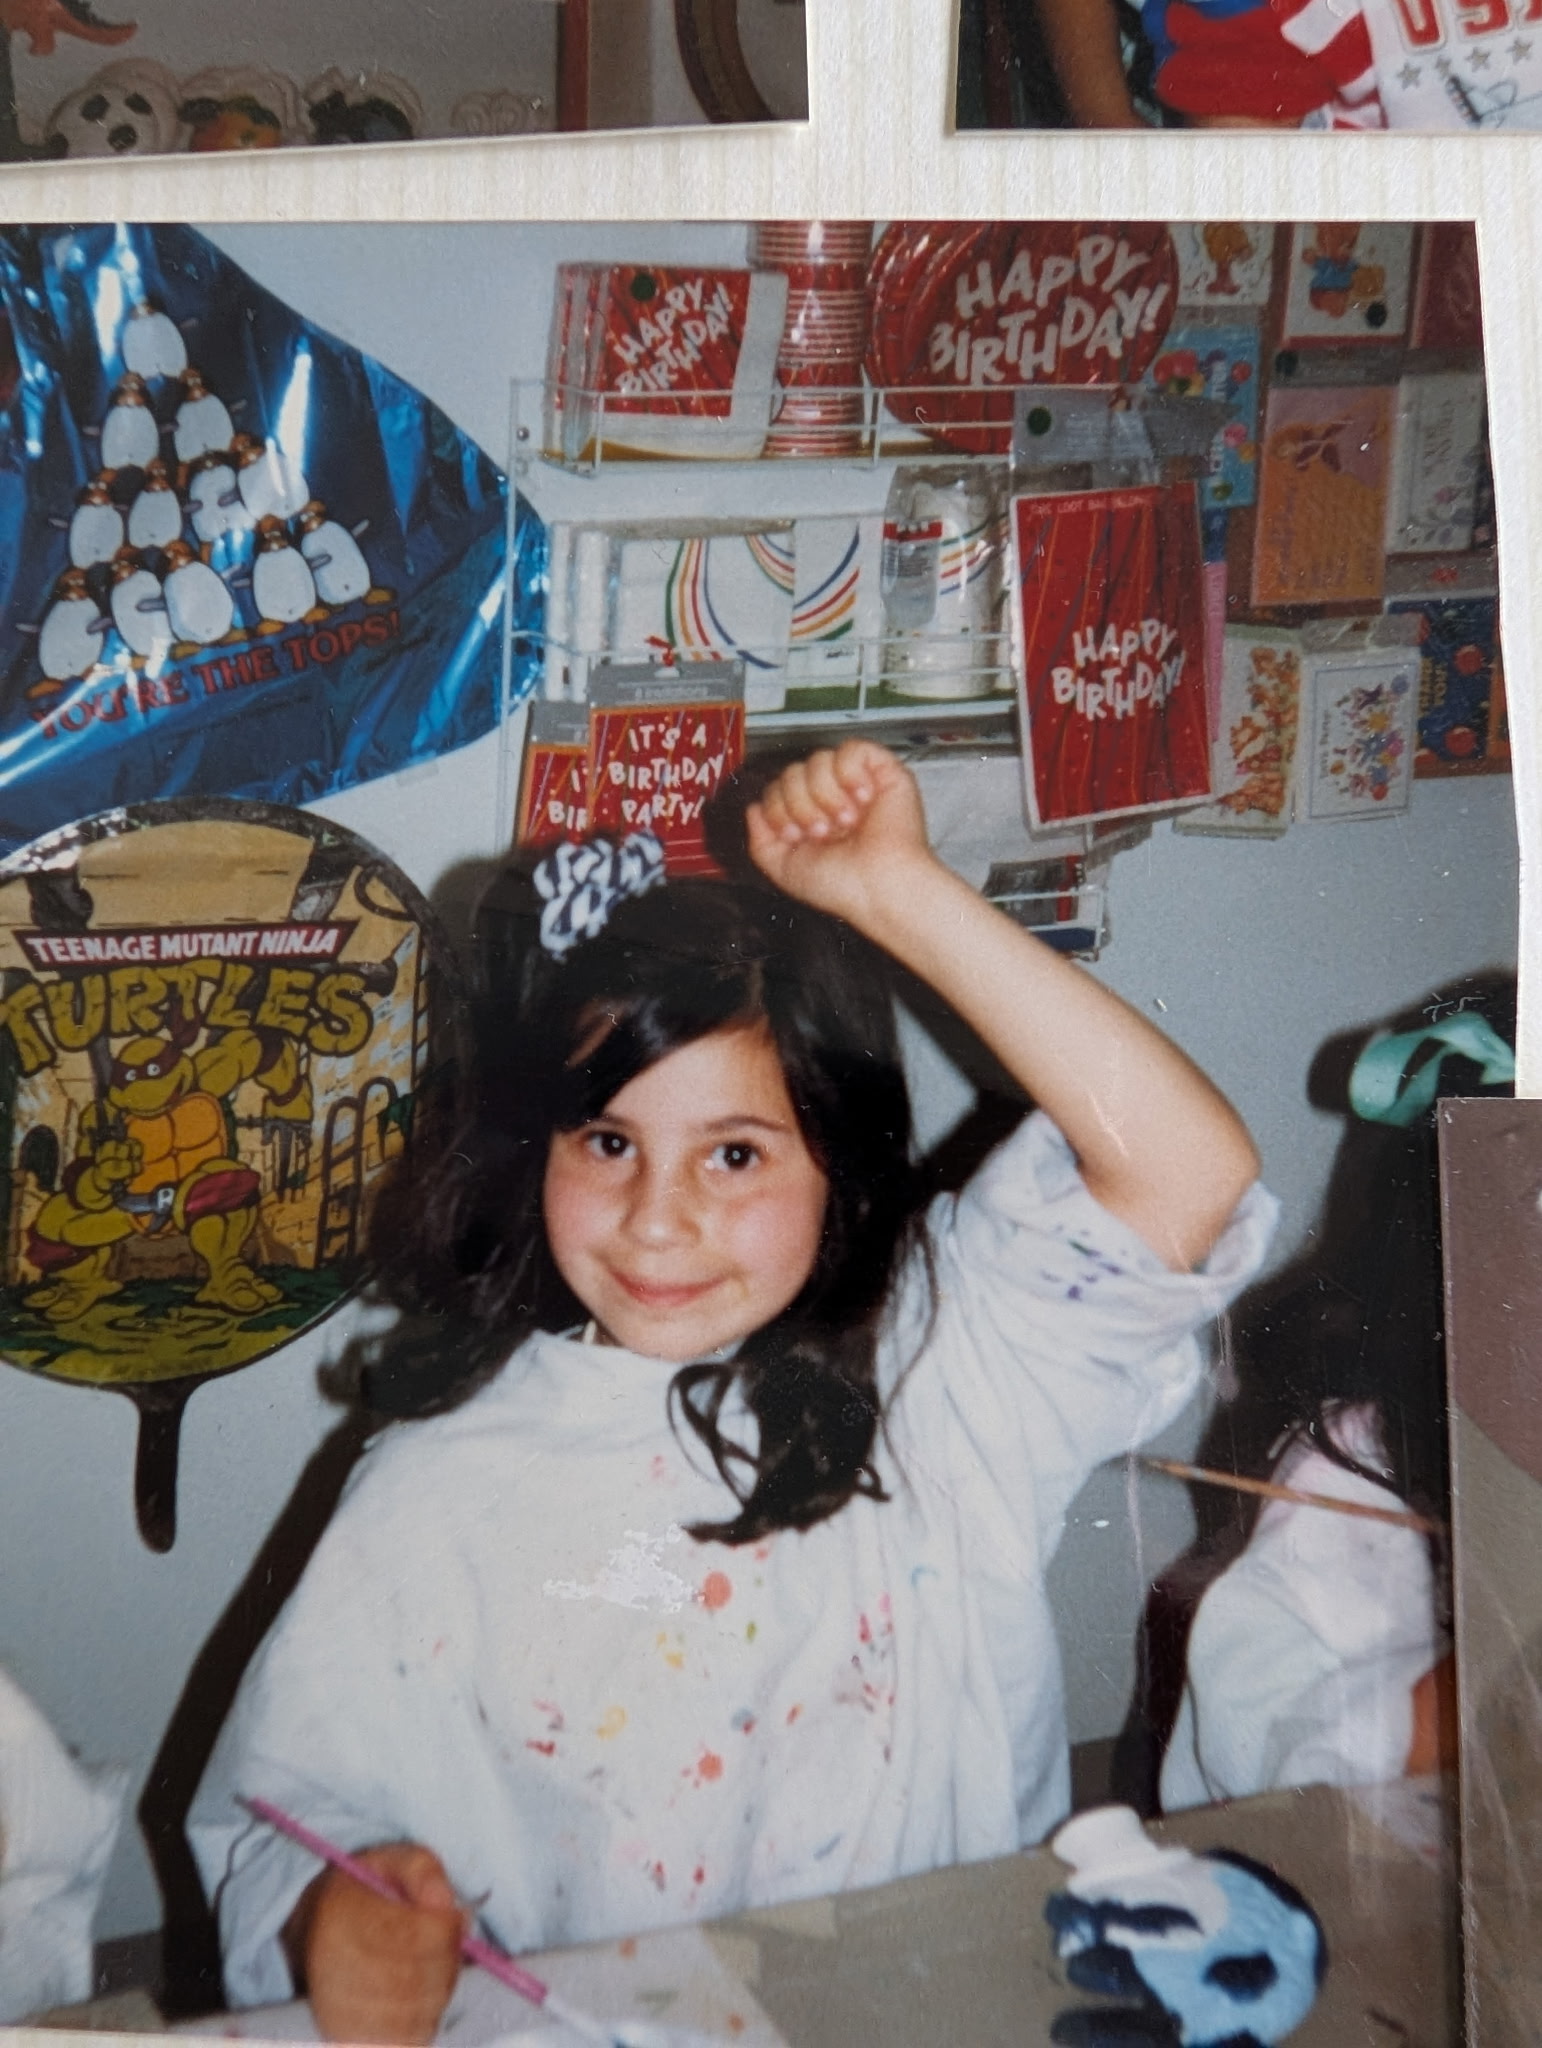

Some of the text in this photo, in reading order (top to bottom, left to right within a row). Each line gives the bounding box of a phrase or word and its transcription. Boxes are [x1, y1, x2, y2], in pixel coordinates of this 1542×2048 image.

[1392, 0, 1542, 50] US
[955, 234, 1150, 320] HAPPY
[613, 278, 703, 365] HAPPY
[615, 282, 734, 395] BIRTHDAY!
[929, 283, 1171, 387] BIRTHDAY!
[192, 645, 281, 695] THE
[283, 609, 399, 670] TOPS!
[1072, 618, 1178, 668] HAPPY
[1051, 649, 1187, 721] BIRTHDAY!
[607, 754, 724, 791] BIRTHDAY
[628, 722, 707, 753] IT'S A
[621, 793, 705, 828] PARTY!
[26, 928, 340, 963] TEENAGE MUTANT NINJA
[0, 957, 376, 1077] TURTLES
